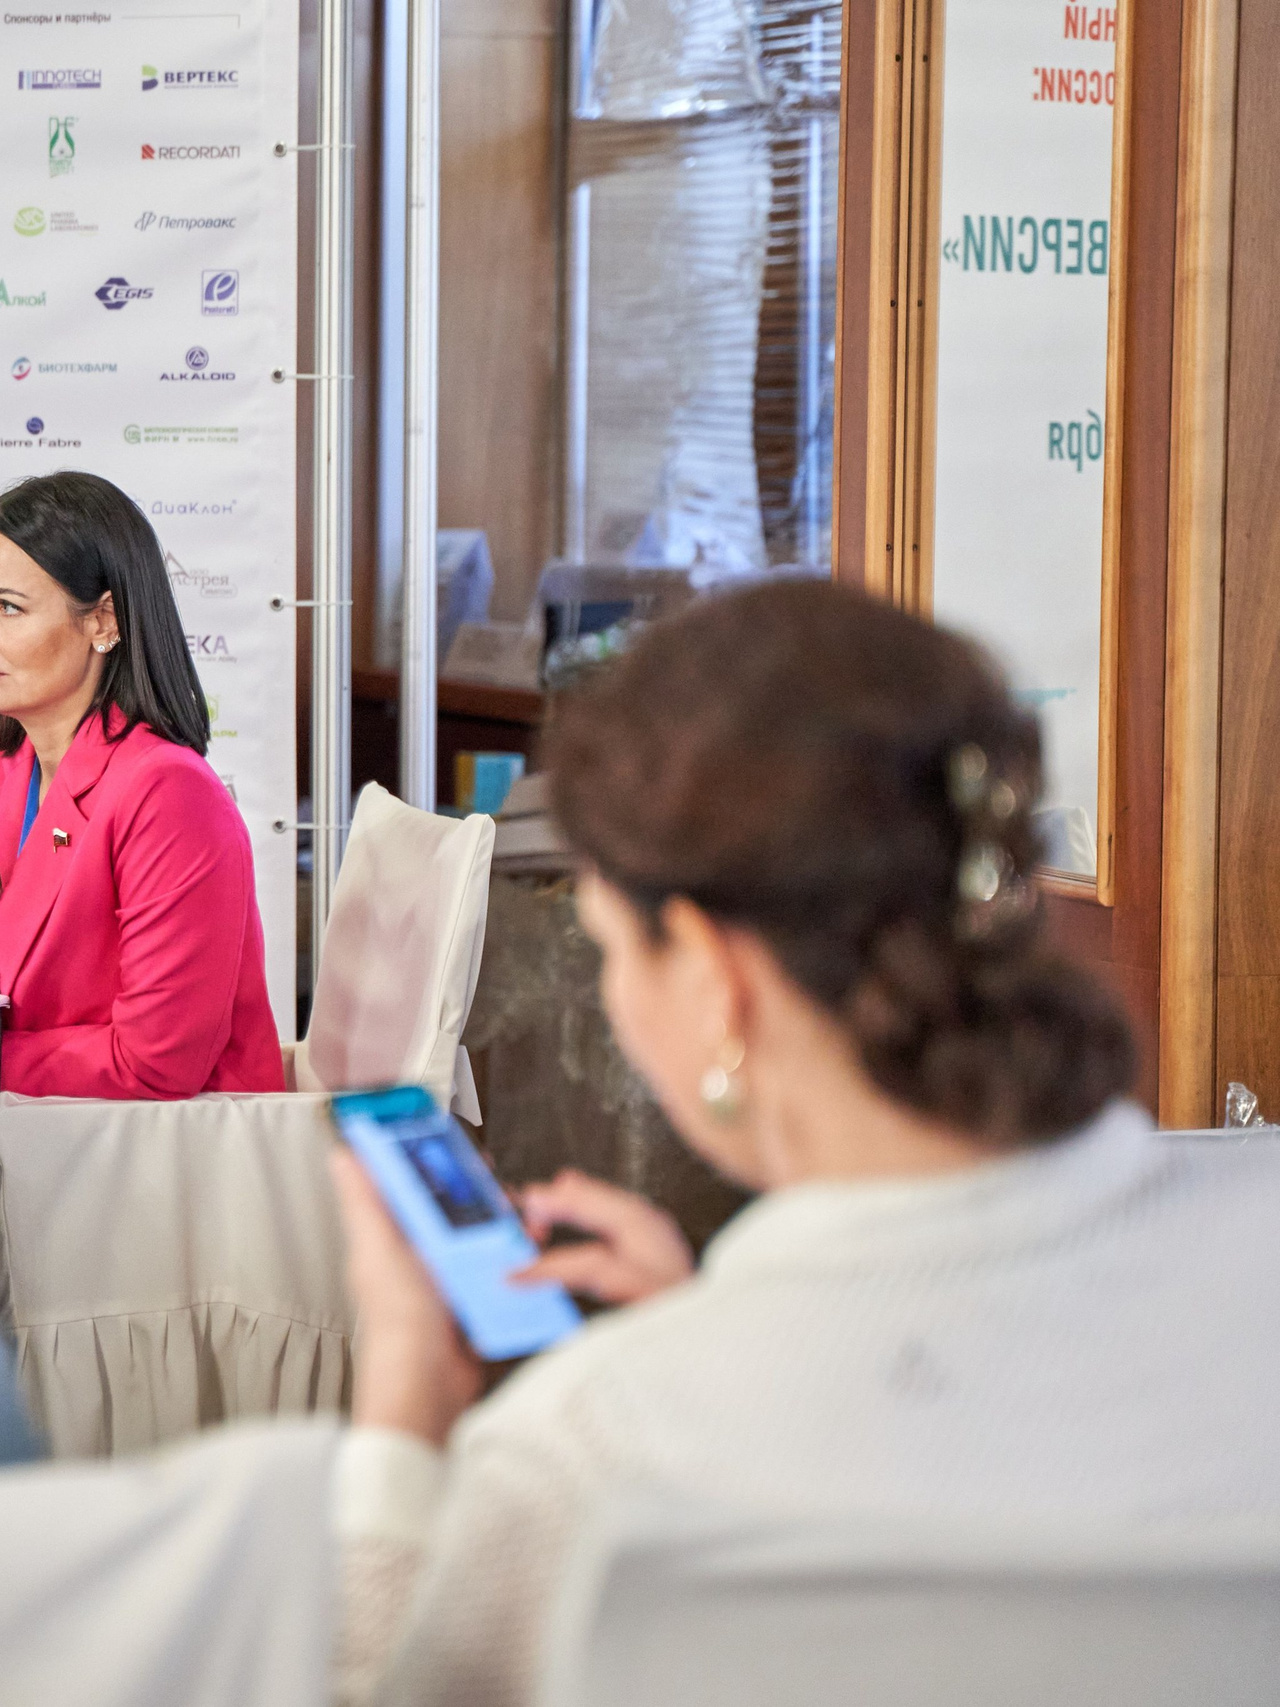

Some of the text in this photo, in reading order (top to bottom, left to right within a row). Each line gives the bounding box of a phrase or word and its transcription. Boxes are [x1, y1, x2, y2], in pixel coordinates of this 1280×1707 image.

[4, 13, 53, 25] Спонсоры
[56, 13, 62, 23] и
[164, 71, 239, 83] ВЕРТЕКС
[159, 146, 240, 160] RECORDATI
[159, 217, 236, 231] Петровакс
[38, 362, 118, 374] БИОТЕХФАРМ
[160, 372, 236, 382] ALKALOID
[39, 437, 82, 448] Fabre
